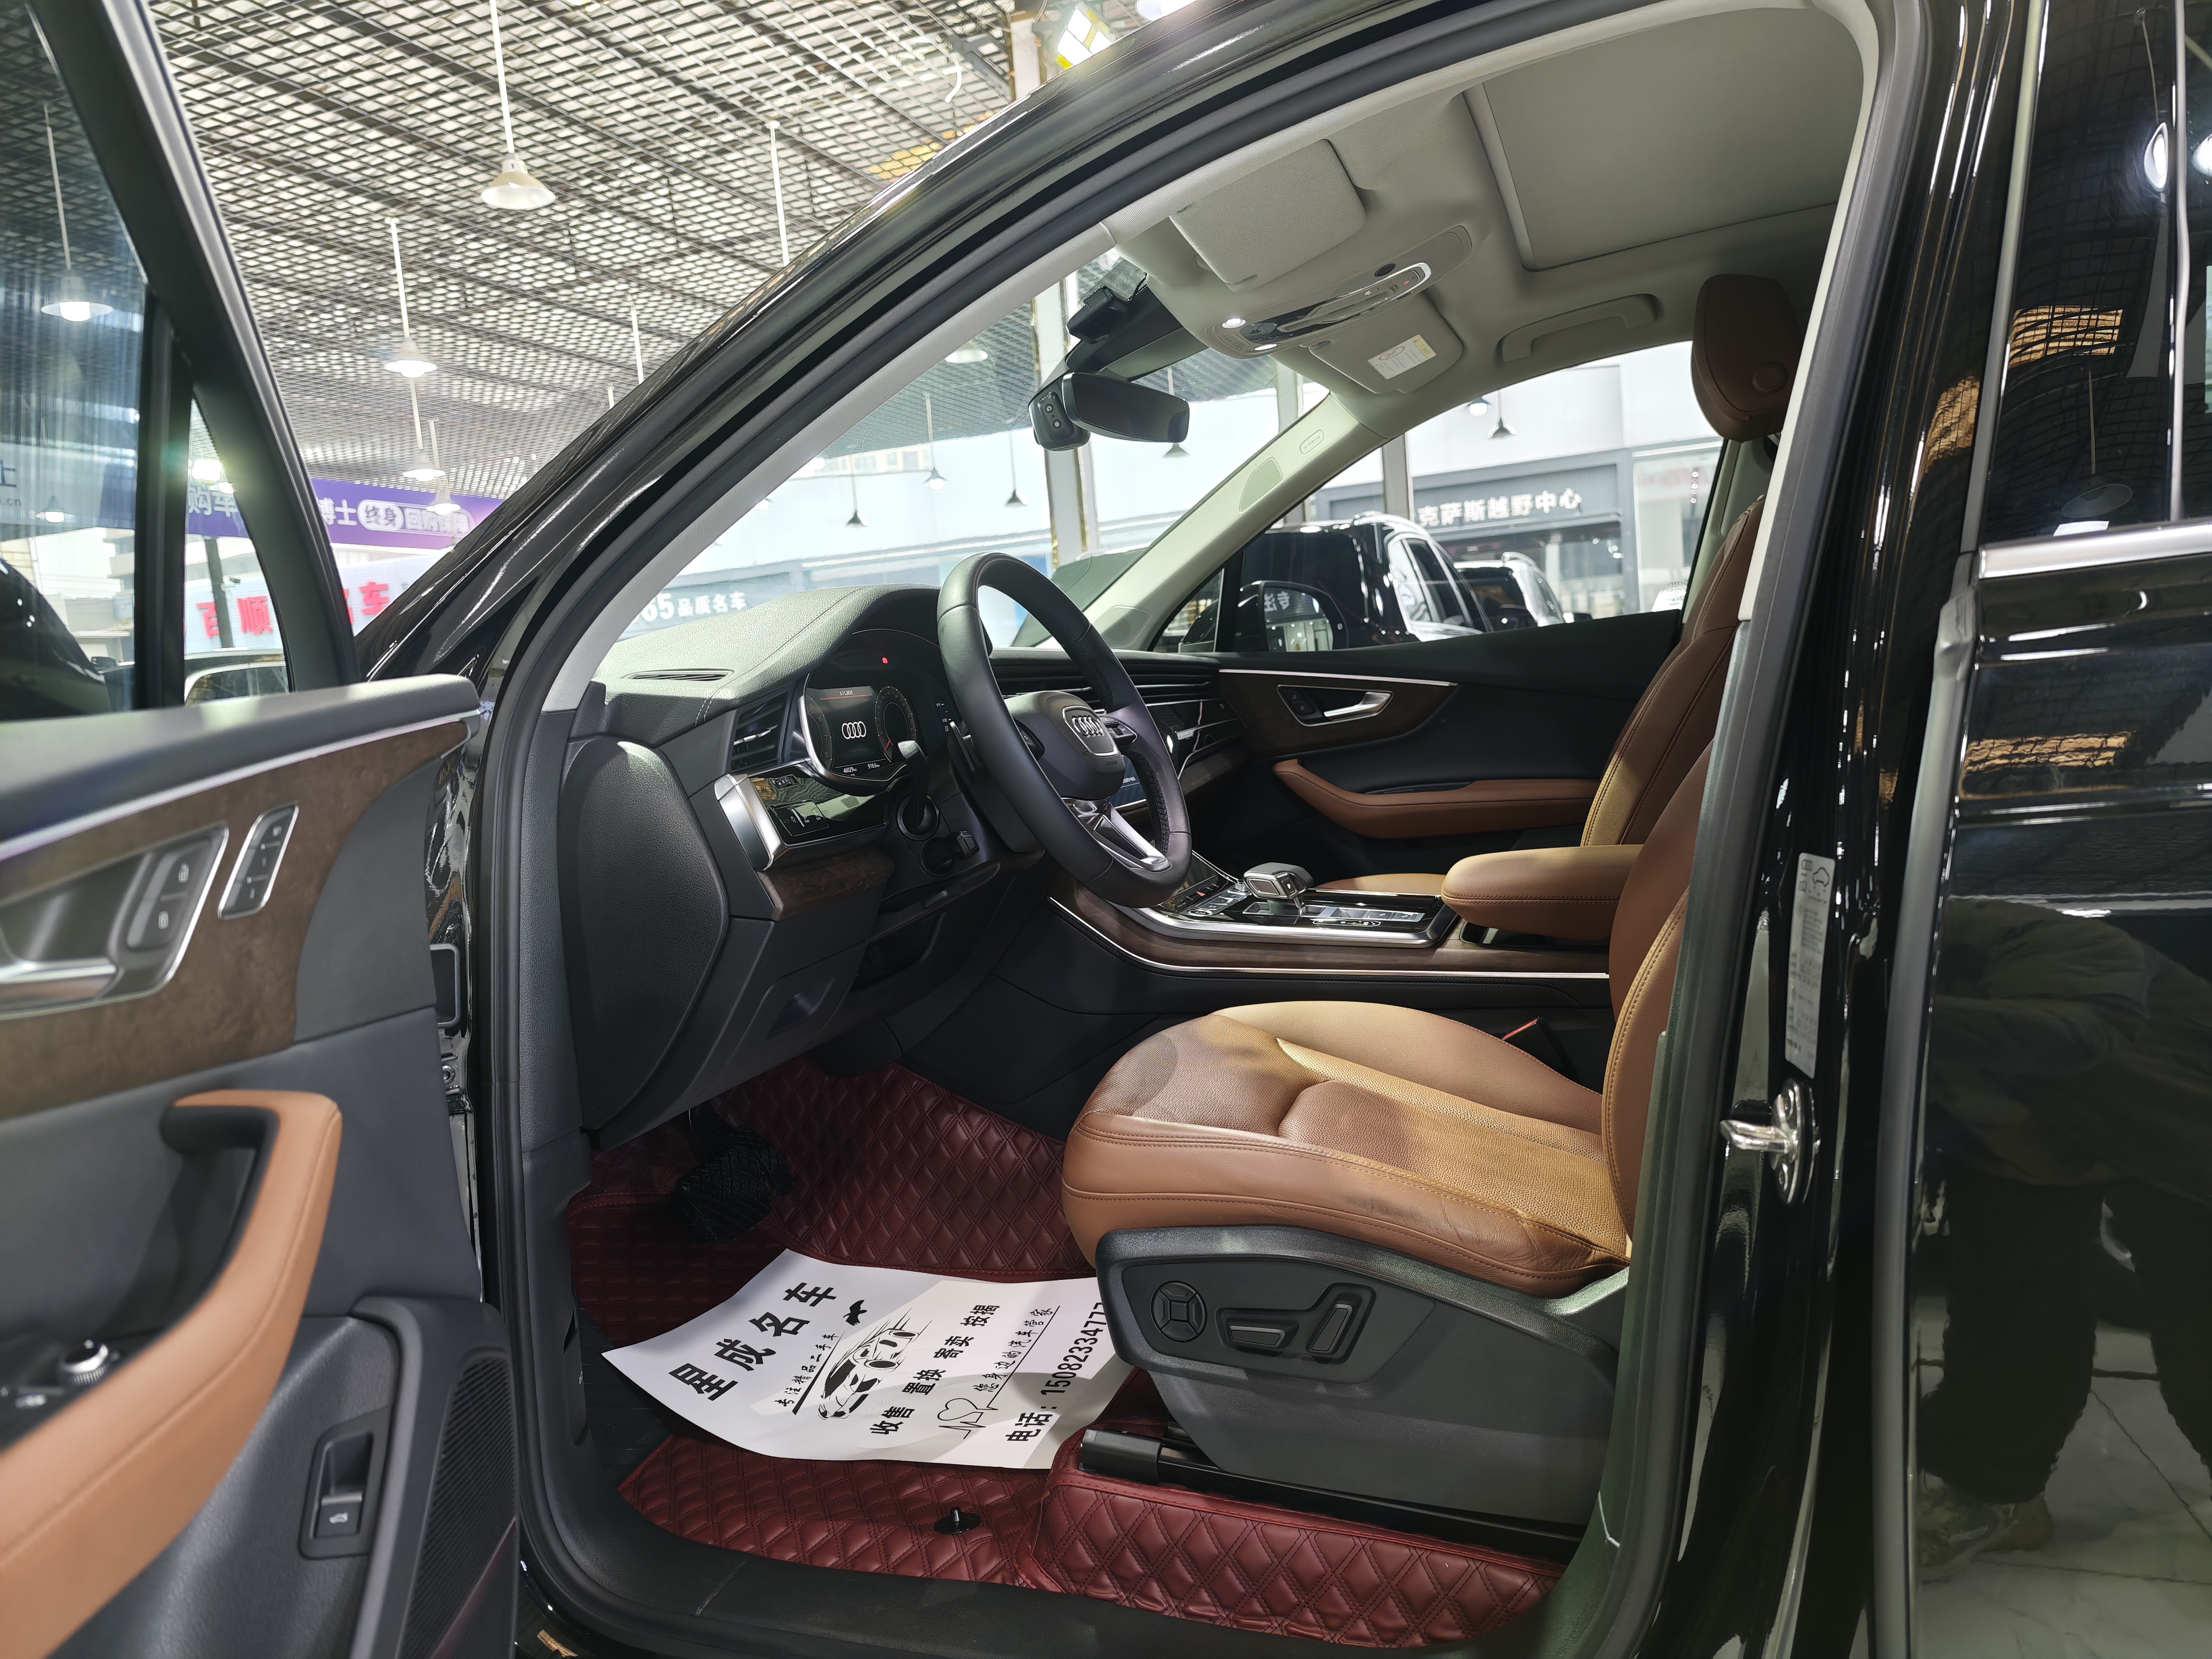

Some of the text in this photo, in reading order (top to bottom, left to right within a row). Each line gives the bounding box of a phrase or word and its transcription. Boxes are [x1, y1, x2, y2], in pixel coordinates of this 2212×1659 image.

[365, 504, 396, 527] 终身
[1417, 488, 1582, 527] 克萨斯越野中心
[631, 591, 746, 623] 65品质名车
[668, 1282, 837, 1401] 星成名车
[869, 1305, 1000, 1435] 收售 置换 寄卖 按揭
[972, 1308, 1054, 1392] 您身边的汽车管家
